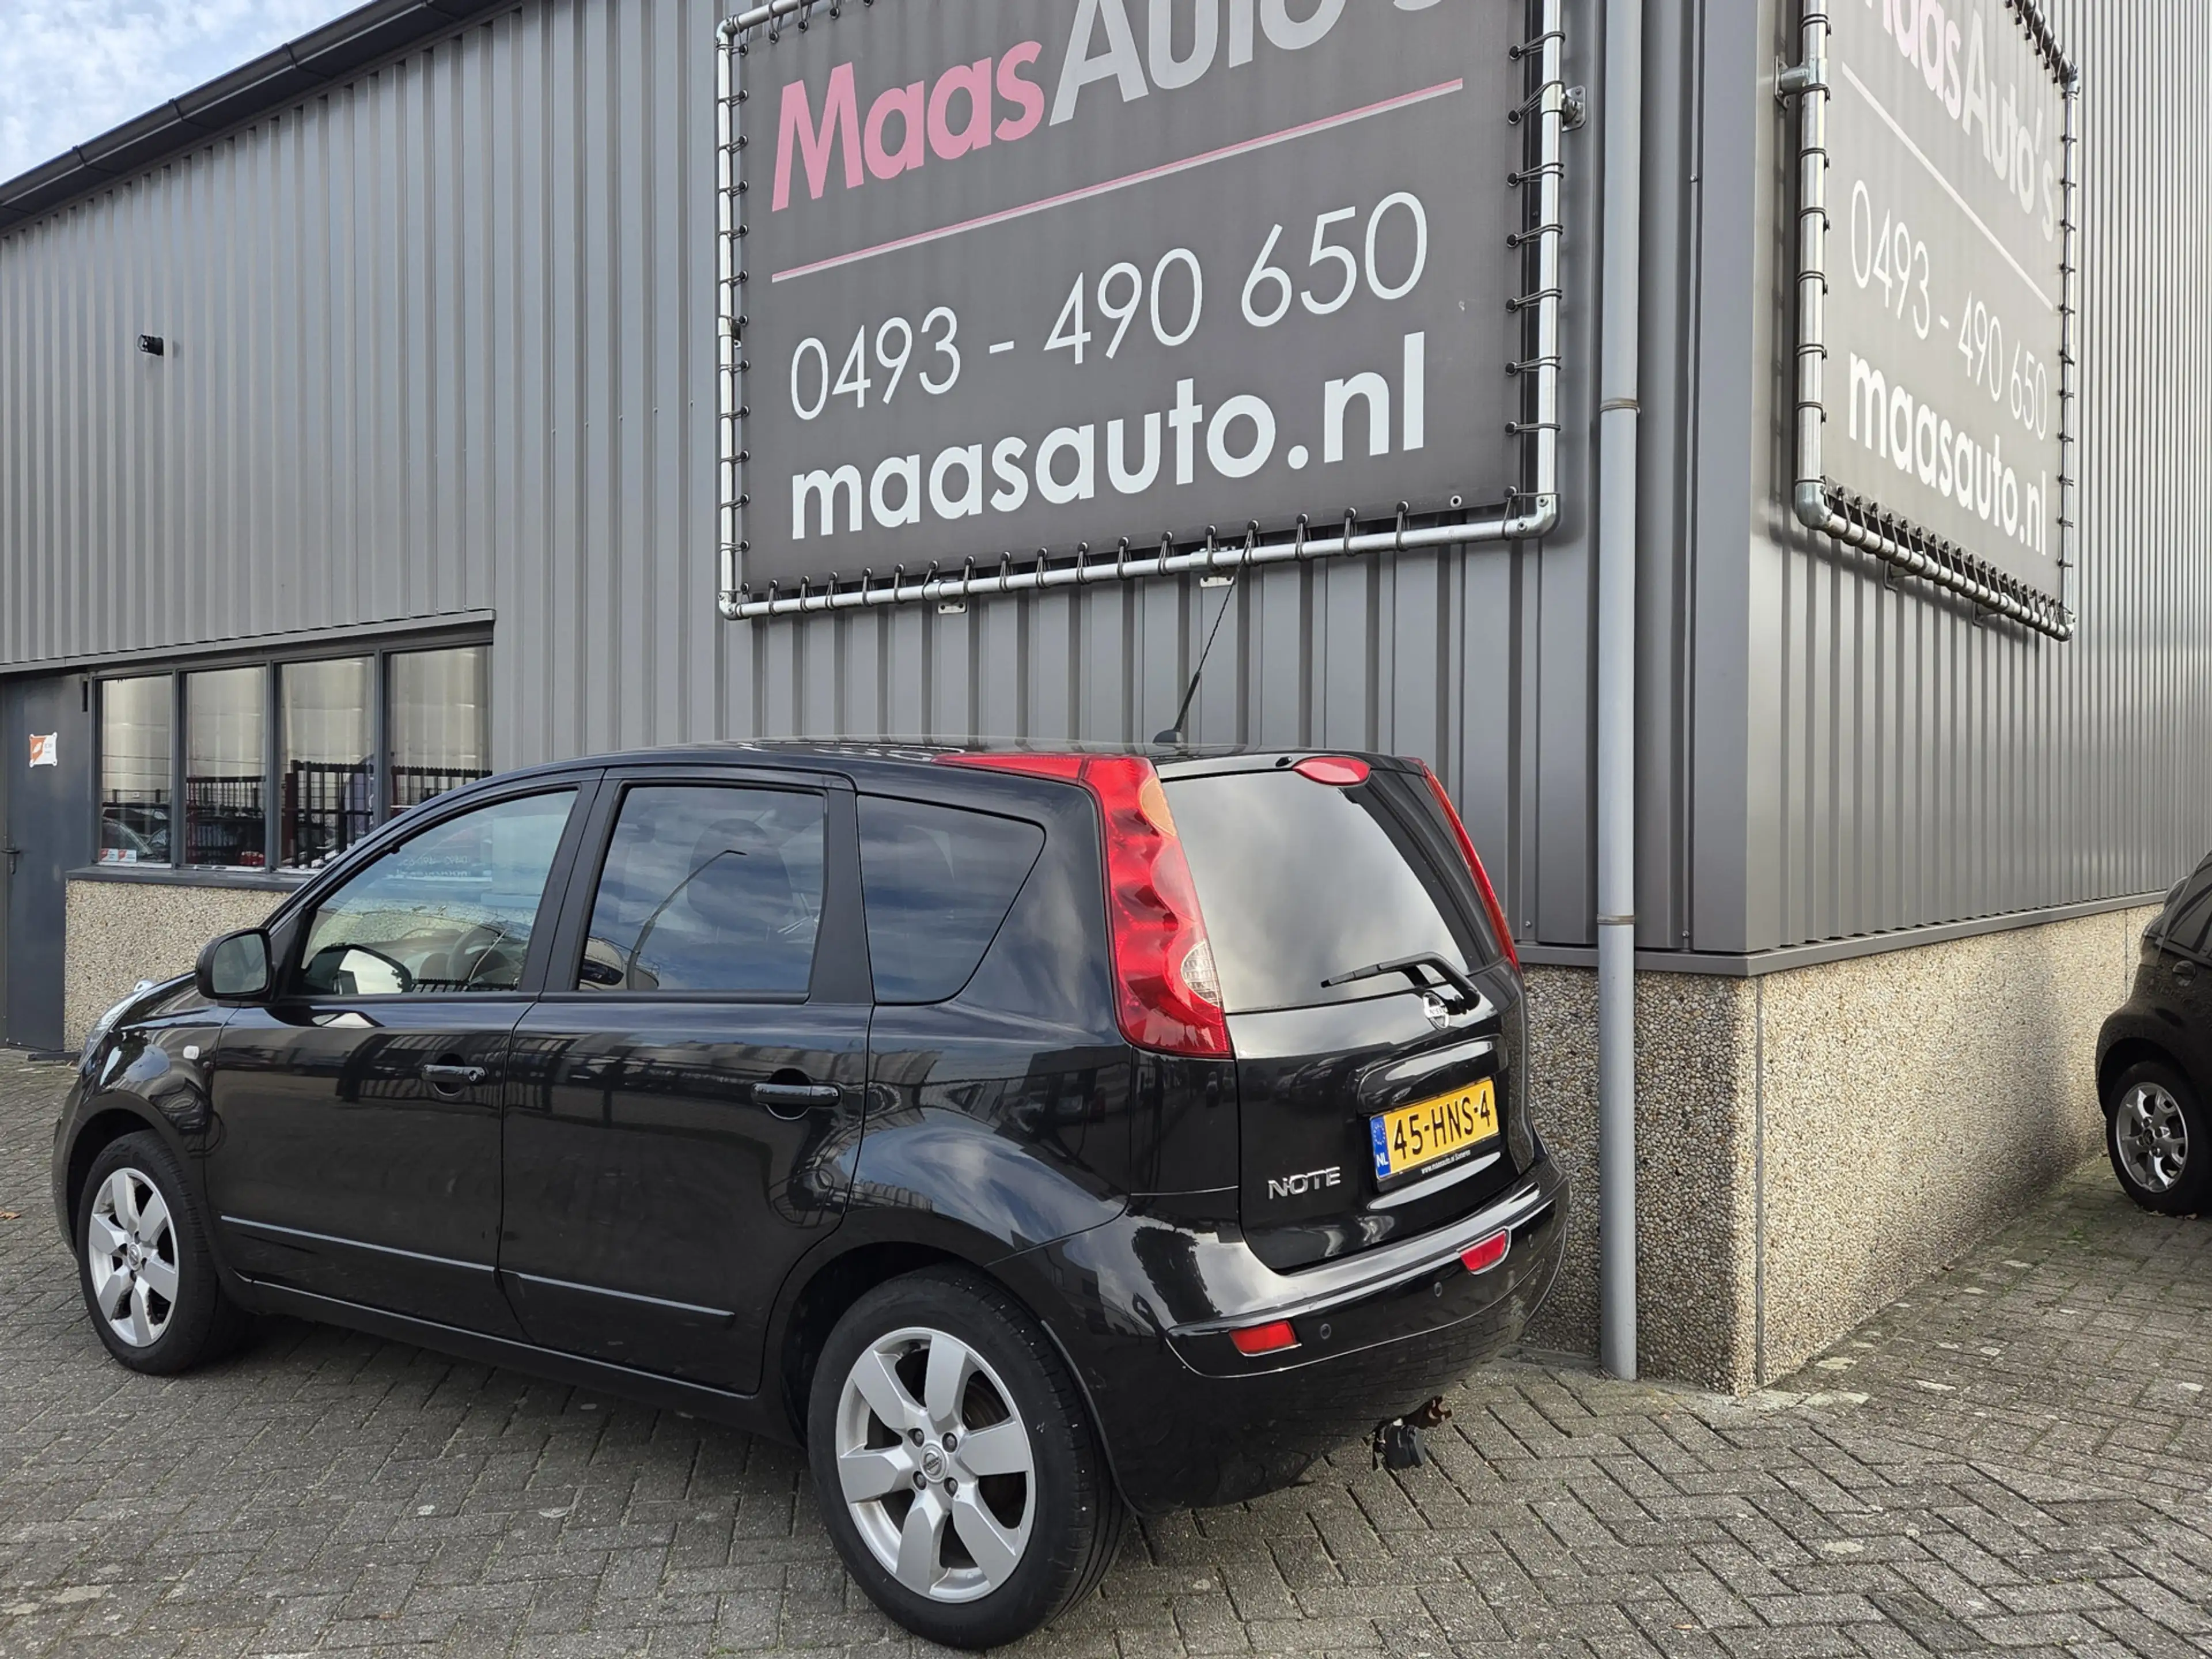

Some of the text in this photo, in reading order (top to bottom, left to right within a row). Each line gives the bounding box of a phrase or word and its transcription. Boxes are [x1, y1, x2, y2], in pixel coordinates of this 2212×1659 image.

[772, 0, 1441, 211] MaasAu
[1865, 0, 2054, 243] aasAuto's
[791, 192, 1427, 421] 0493 - 490 650
[1851, 179, 2047, 441] 0493 - 490 650
[792, 331, 1425, 540] maasauto.nl
[1849, 351, 2047, 556] maasauto.nl
[1268, 1166, 1340, 1199] NOTE
[1376, 1152, 1389, 1168] NL
[1394, 1090, 1491, 1160] 45-HNS-4
